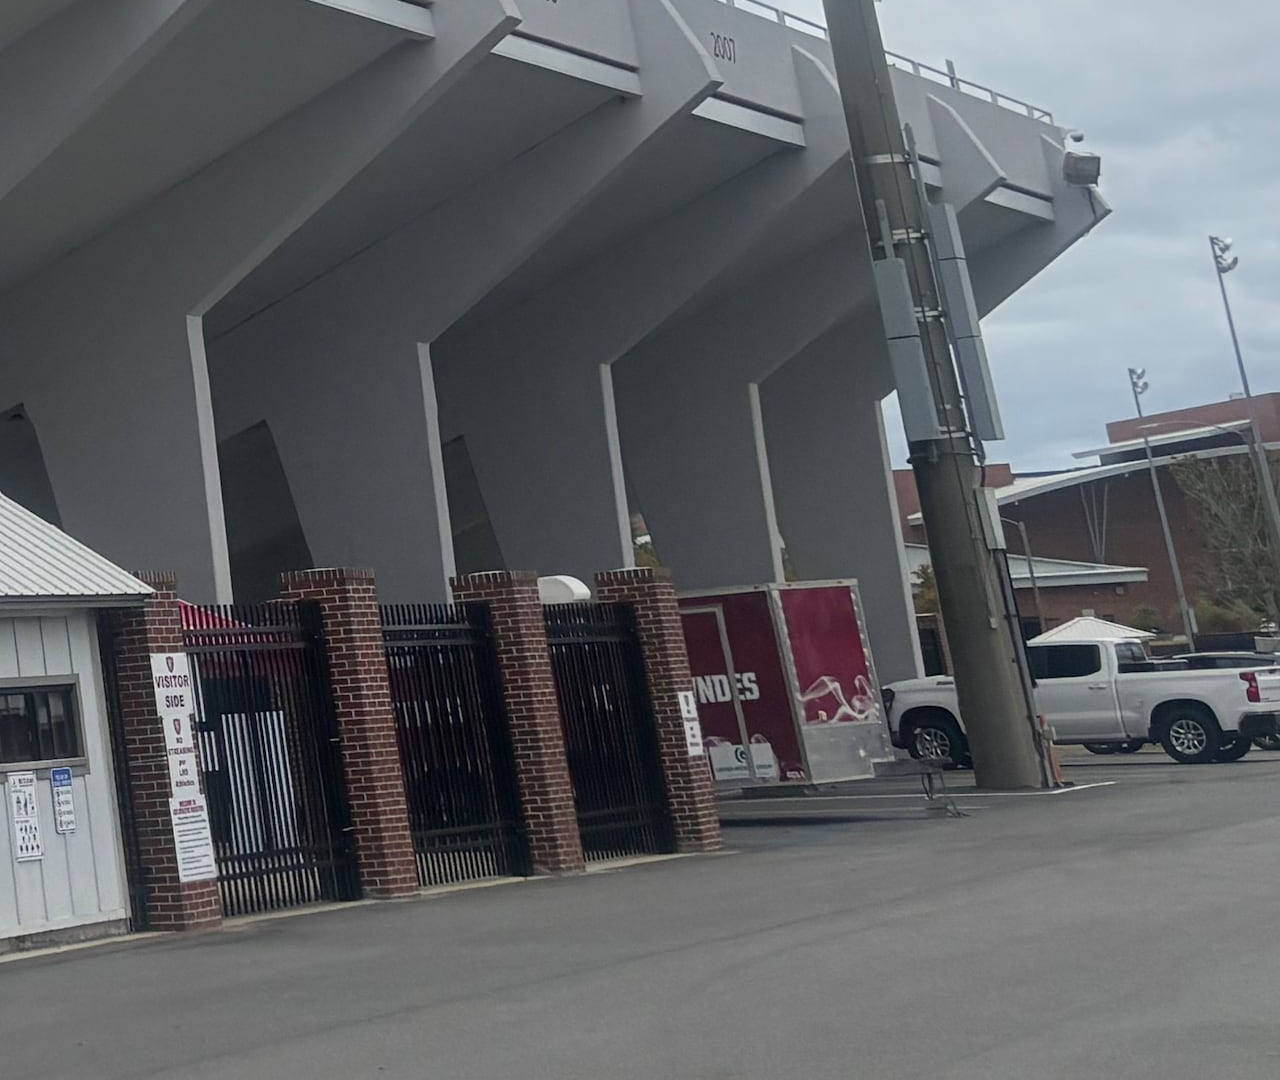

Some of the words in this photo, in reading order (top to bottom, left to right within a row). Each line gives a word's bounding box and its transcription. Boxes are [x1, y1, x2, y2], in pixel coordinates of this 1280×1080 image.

[710, 31, 737, 64] 2007
[155, 674, 189, 689] VISITOR
[165, 694, 185, 708] SIDE
